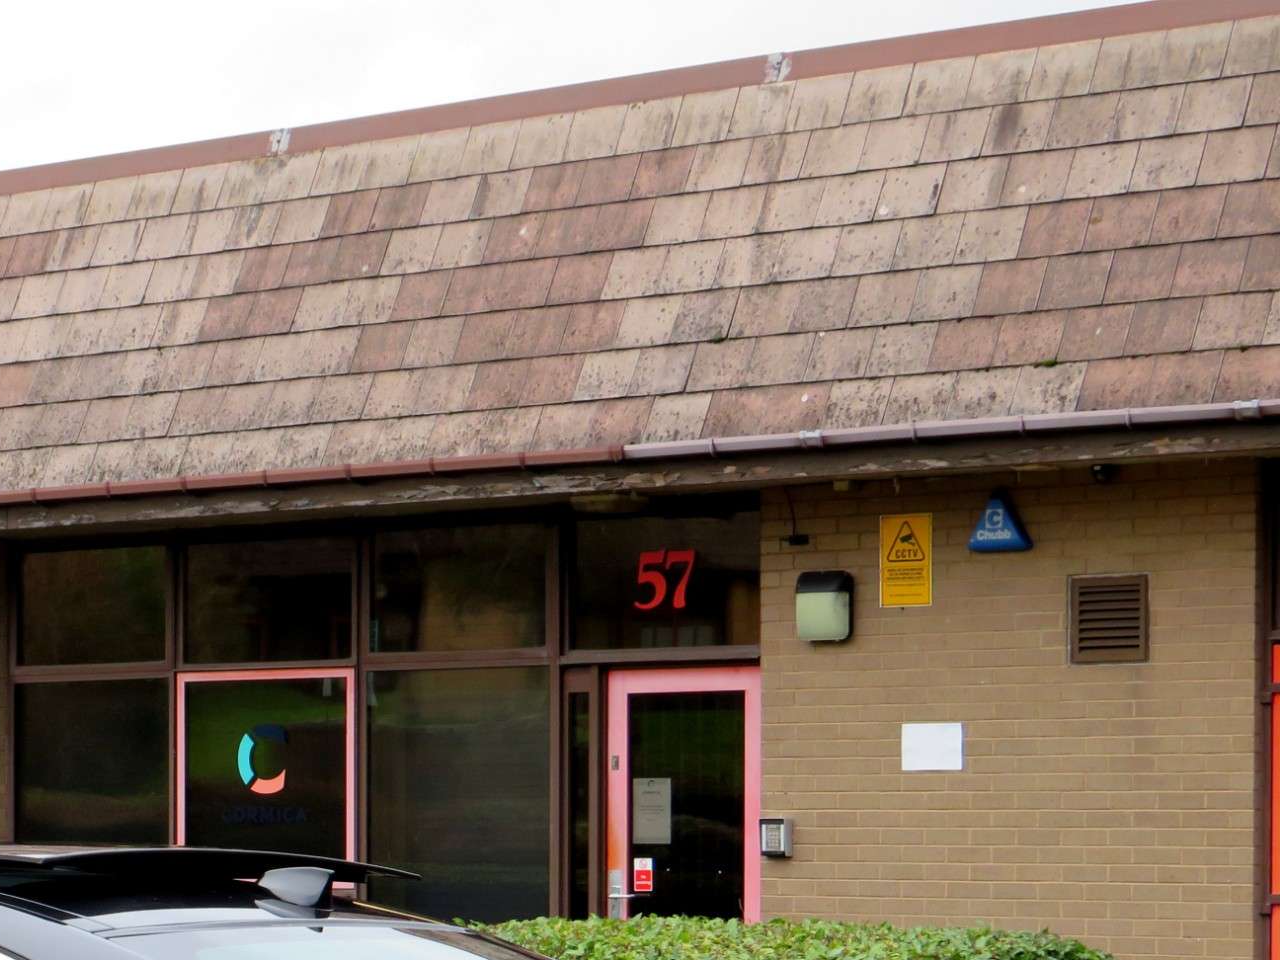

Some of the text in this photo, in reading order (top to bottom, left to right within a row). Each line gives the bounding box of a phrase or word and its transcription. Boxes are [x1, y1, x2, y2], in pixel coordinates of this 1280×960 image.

[977, 529, 1011, 540] Chubb
[895, 548, 918, 559] CCTV
[634, 547, 695, 609] 57
